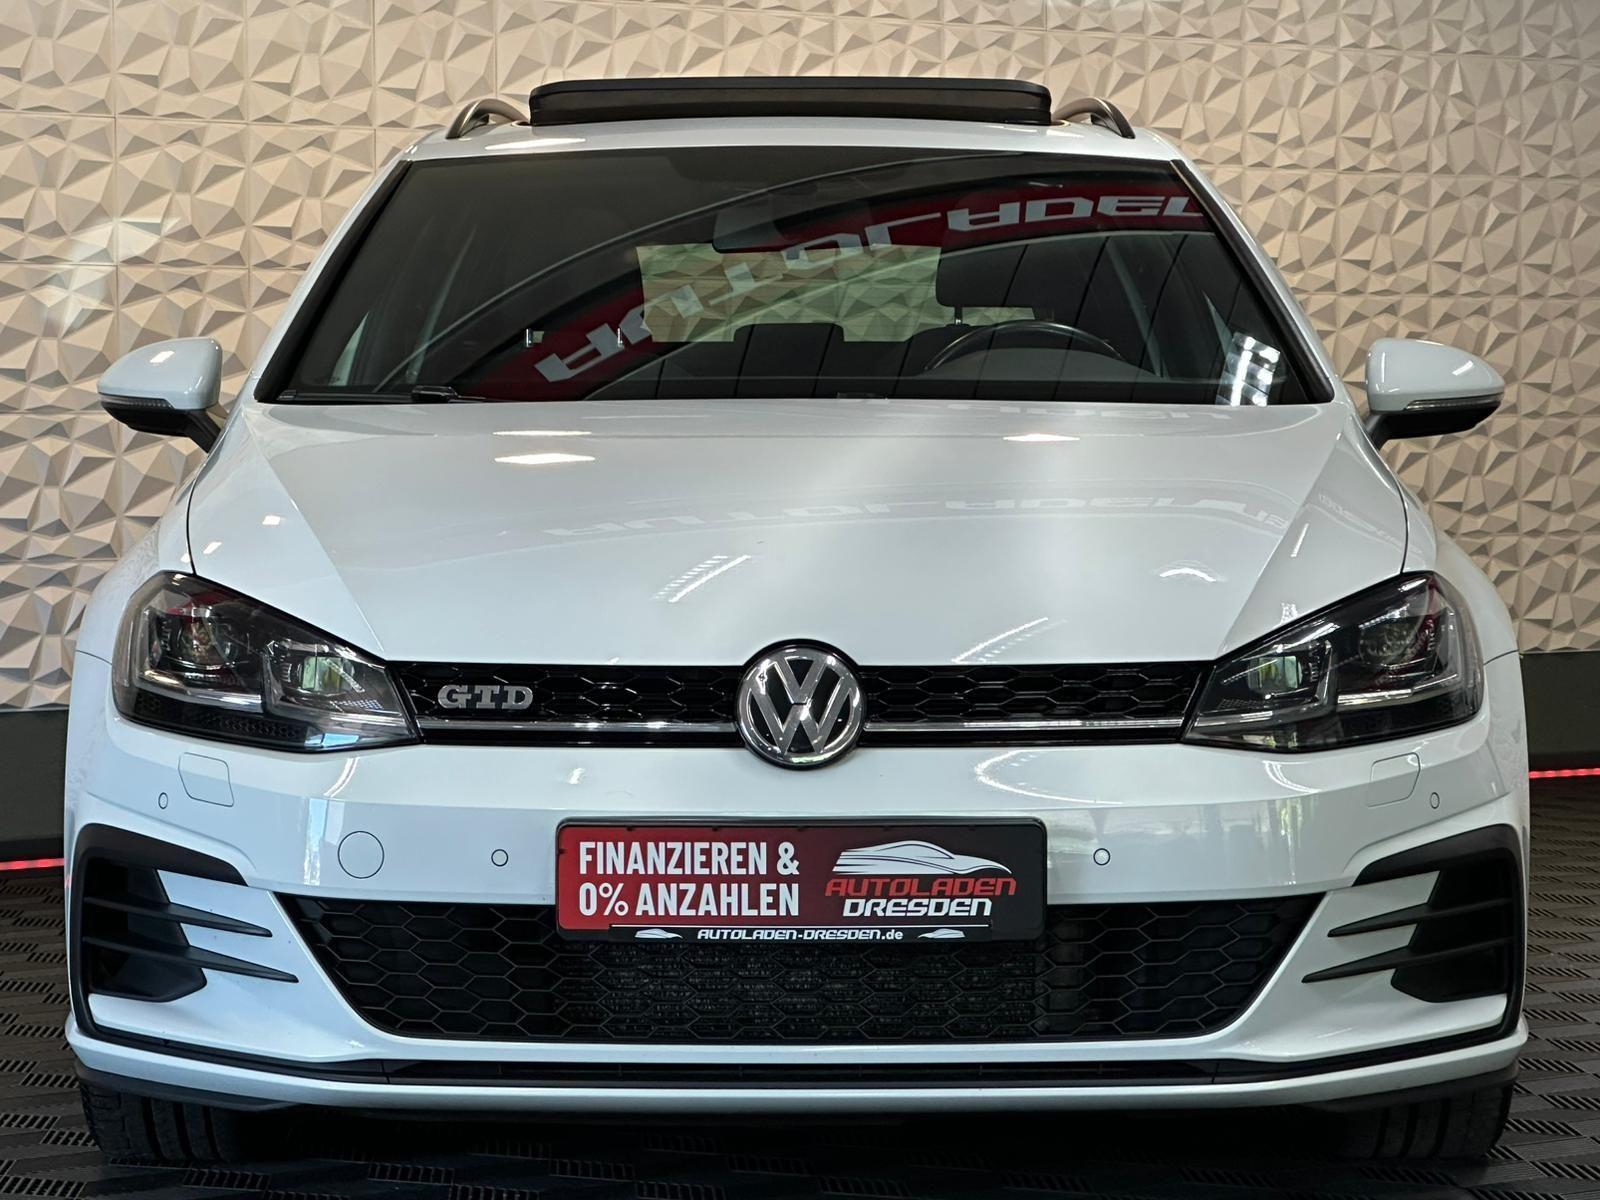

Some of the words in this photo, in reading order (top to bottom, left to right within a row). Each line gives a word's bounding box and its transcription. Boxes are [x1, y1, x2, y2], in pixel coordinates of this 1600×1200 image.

[437, 684, 534, 710] GTD
[579, 841, 767, 875] FINANZIEREN
[776, 841, 800, 875] &
[825, 877, 1017, 897] AUTOLADEN
[579, 882, 629, 916] 0%
[635, 883, 799, 916] ANZAHLEN
[843, 898, 993, 917] DRESDEN
[697, 928, 904, 940] AUTOLADEN-DRESDEN.de
